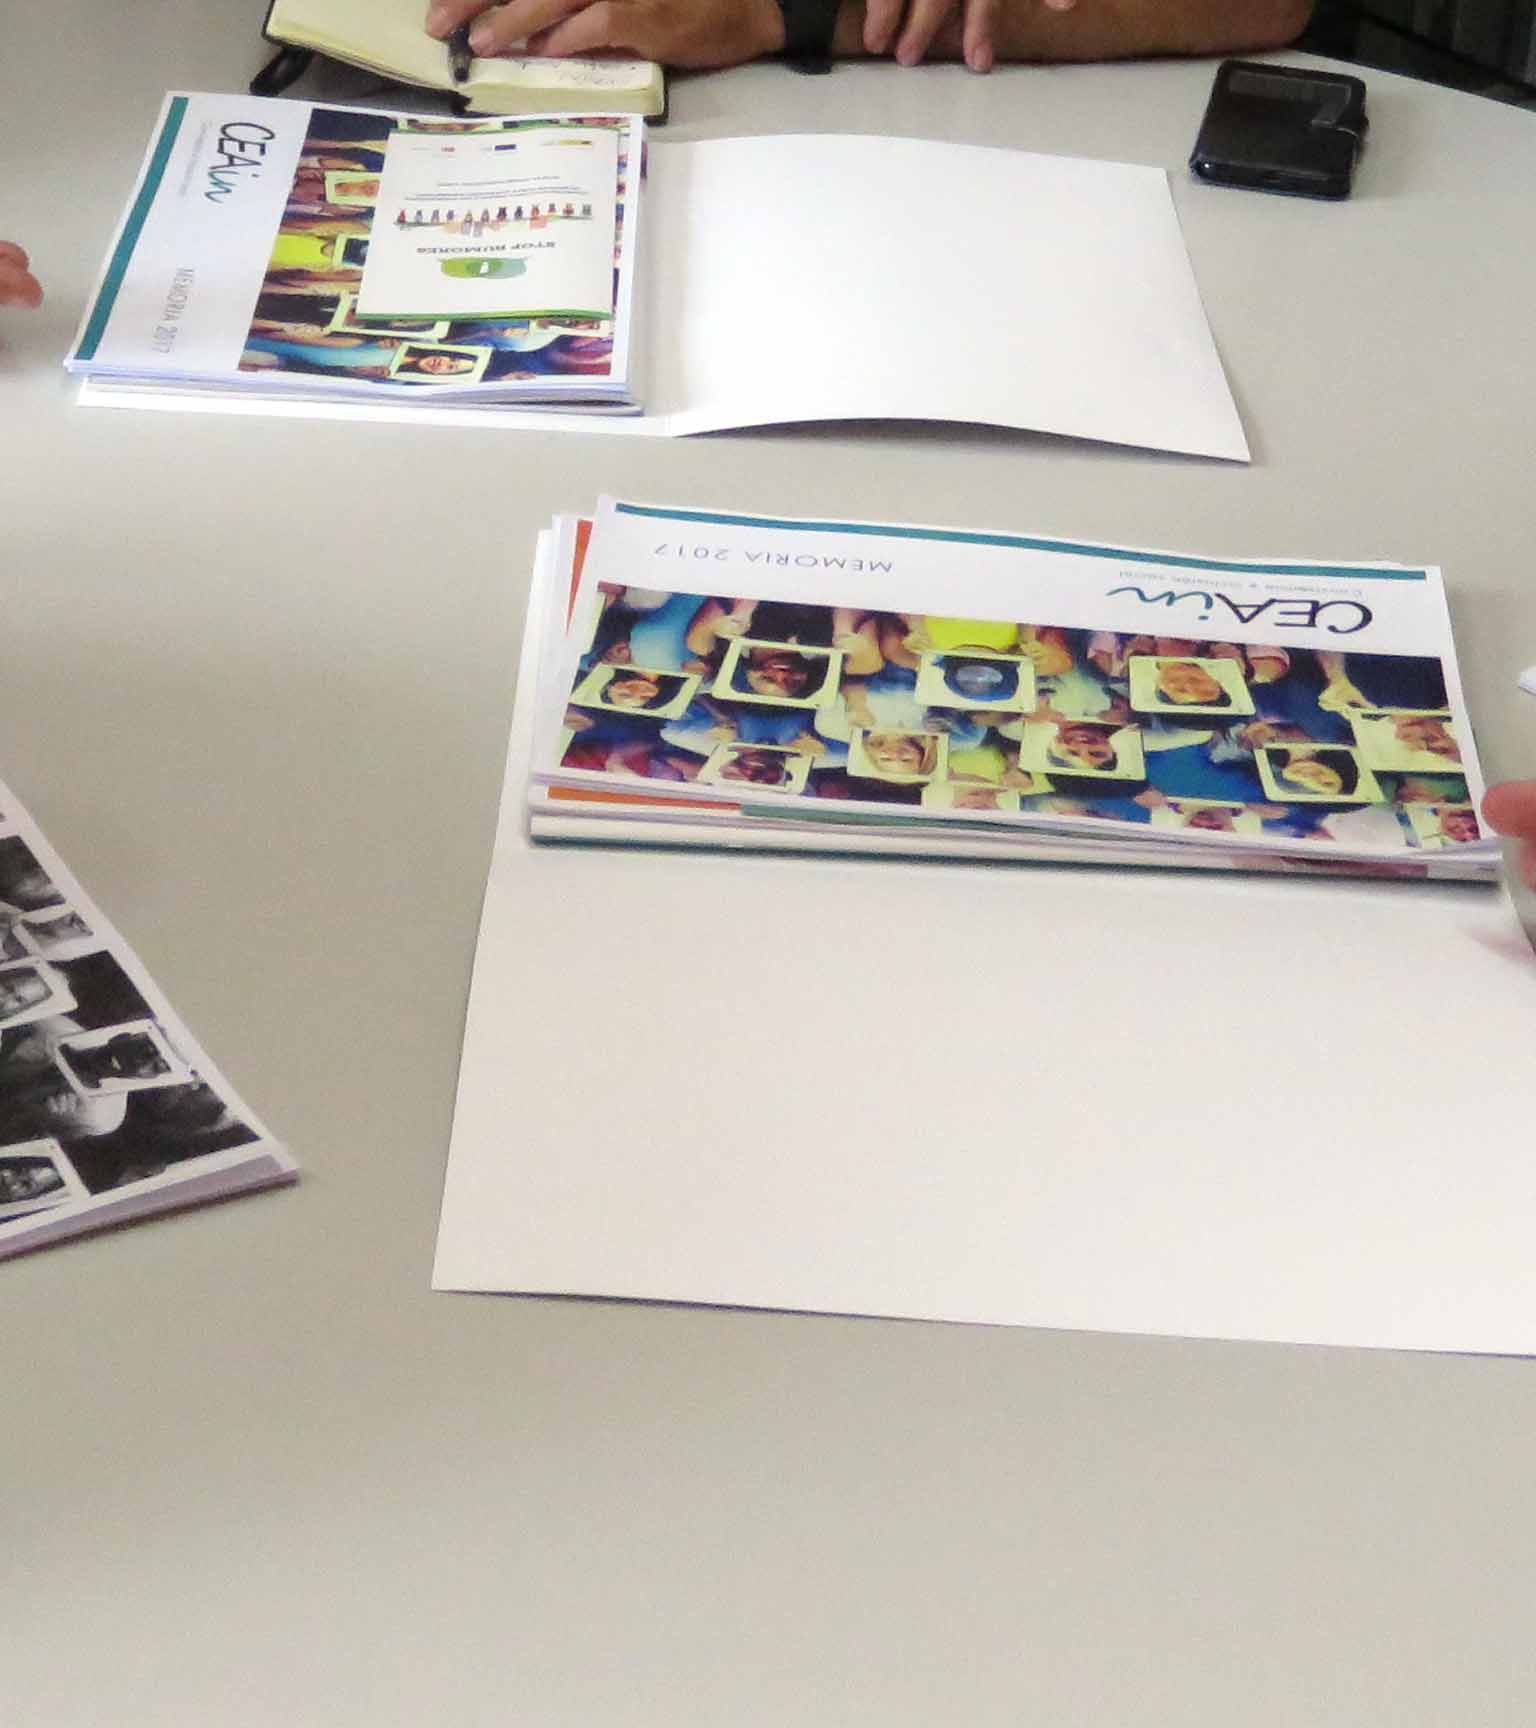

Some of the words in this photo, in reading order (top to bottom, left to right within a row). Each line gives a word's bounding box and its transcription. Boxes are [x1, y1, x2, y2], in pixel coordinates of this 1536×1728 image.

[204, 120, 277, 203] CEAin
[415, 242, 507, 255] RUMORES
[510, 240, 558, 252] STOP
[163, 266, 195, 321] MEMORIA
[151, 325, 177, 355] 2017
[654, 542, 730, 562] 2017
[744, 550, 893, 573] MEMORIA
[1106, 586, 1373, 634] CEAin
